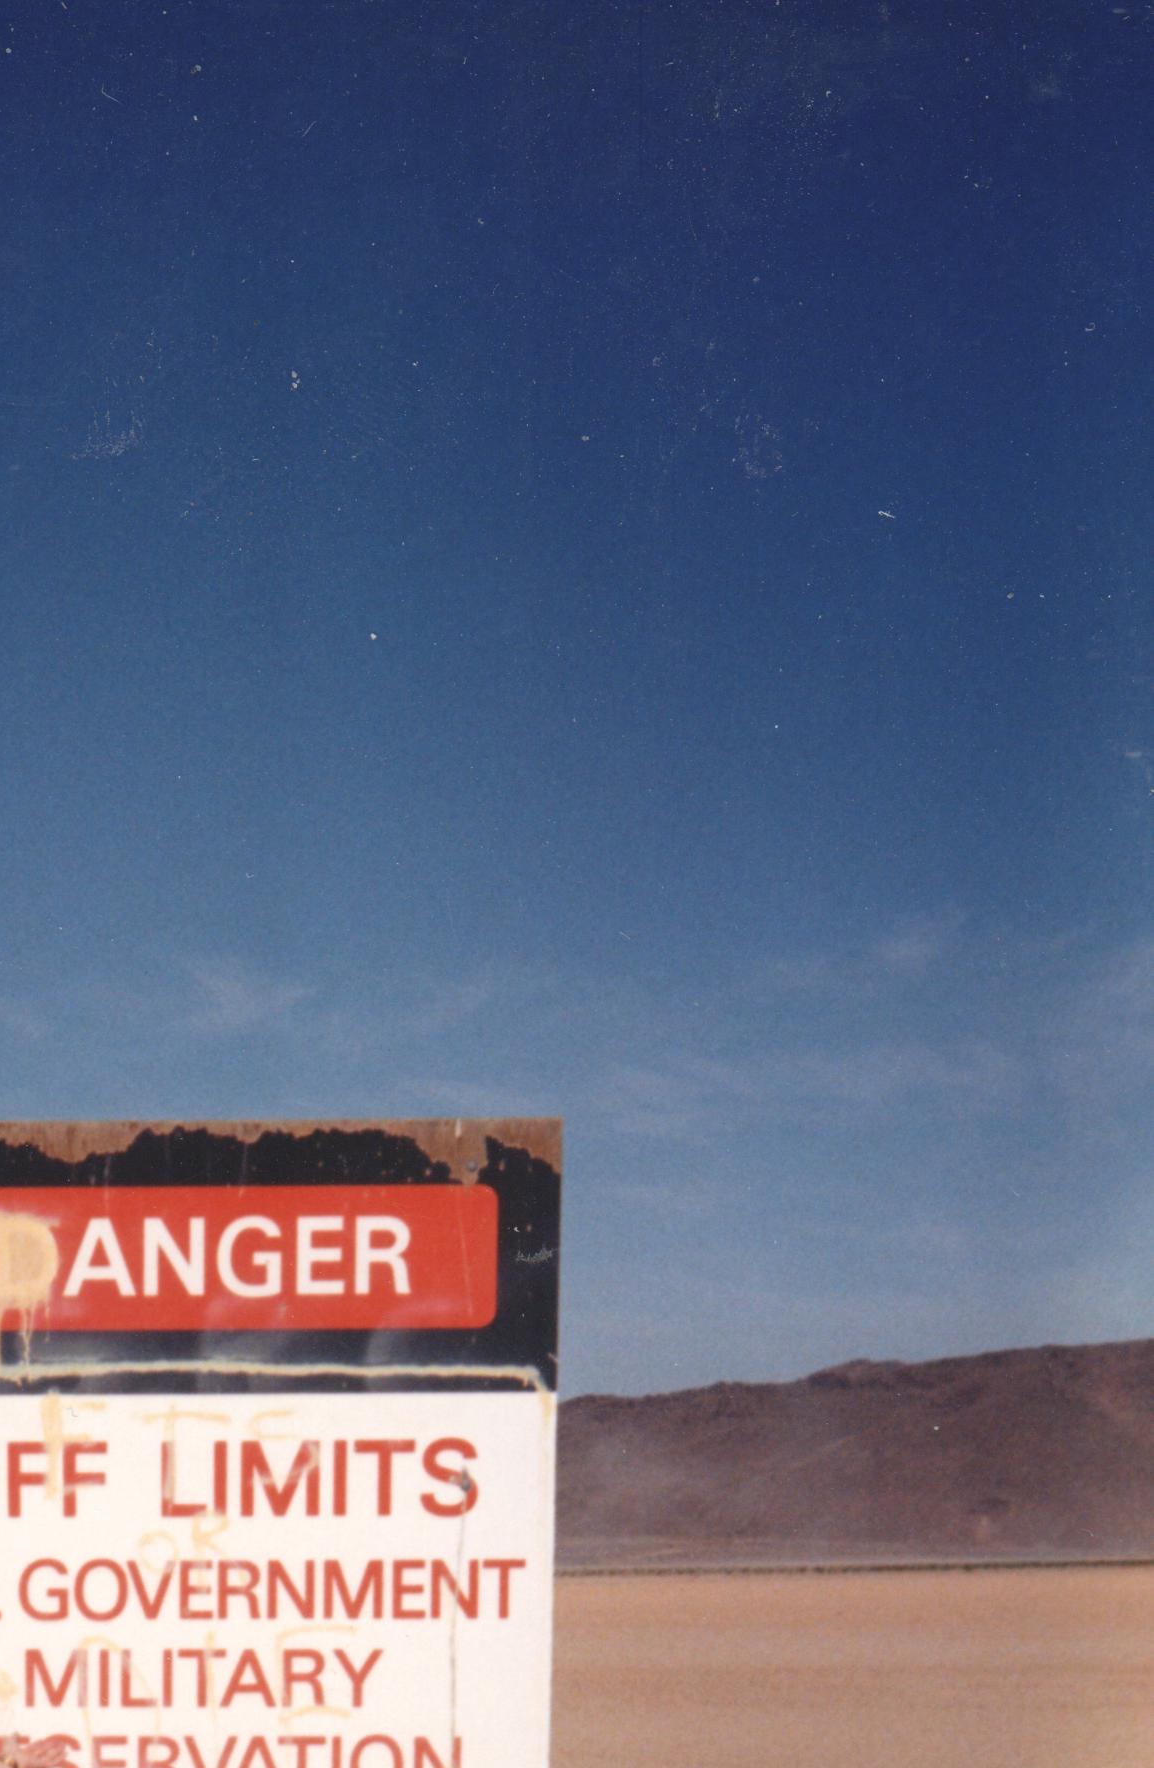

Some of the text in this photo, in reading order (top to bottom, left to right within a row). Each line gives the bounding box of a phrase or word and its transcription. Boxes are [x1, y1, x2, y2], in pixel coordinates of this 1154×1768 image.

[160, 1436, 480, 1519] LIMITS
[18, 1557, 528, 1622] GOVERNMENT
[24, 1648, 384, 1709] MILITARY
